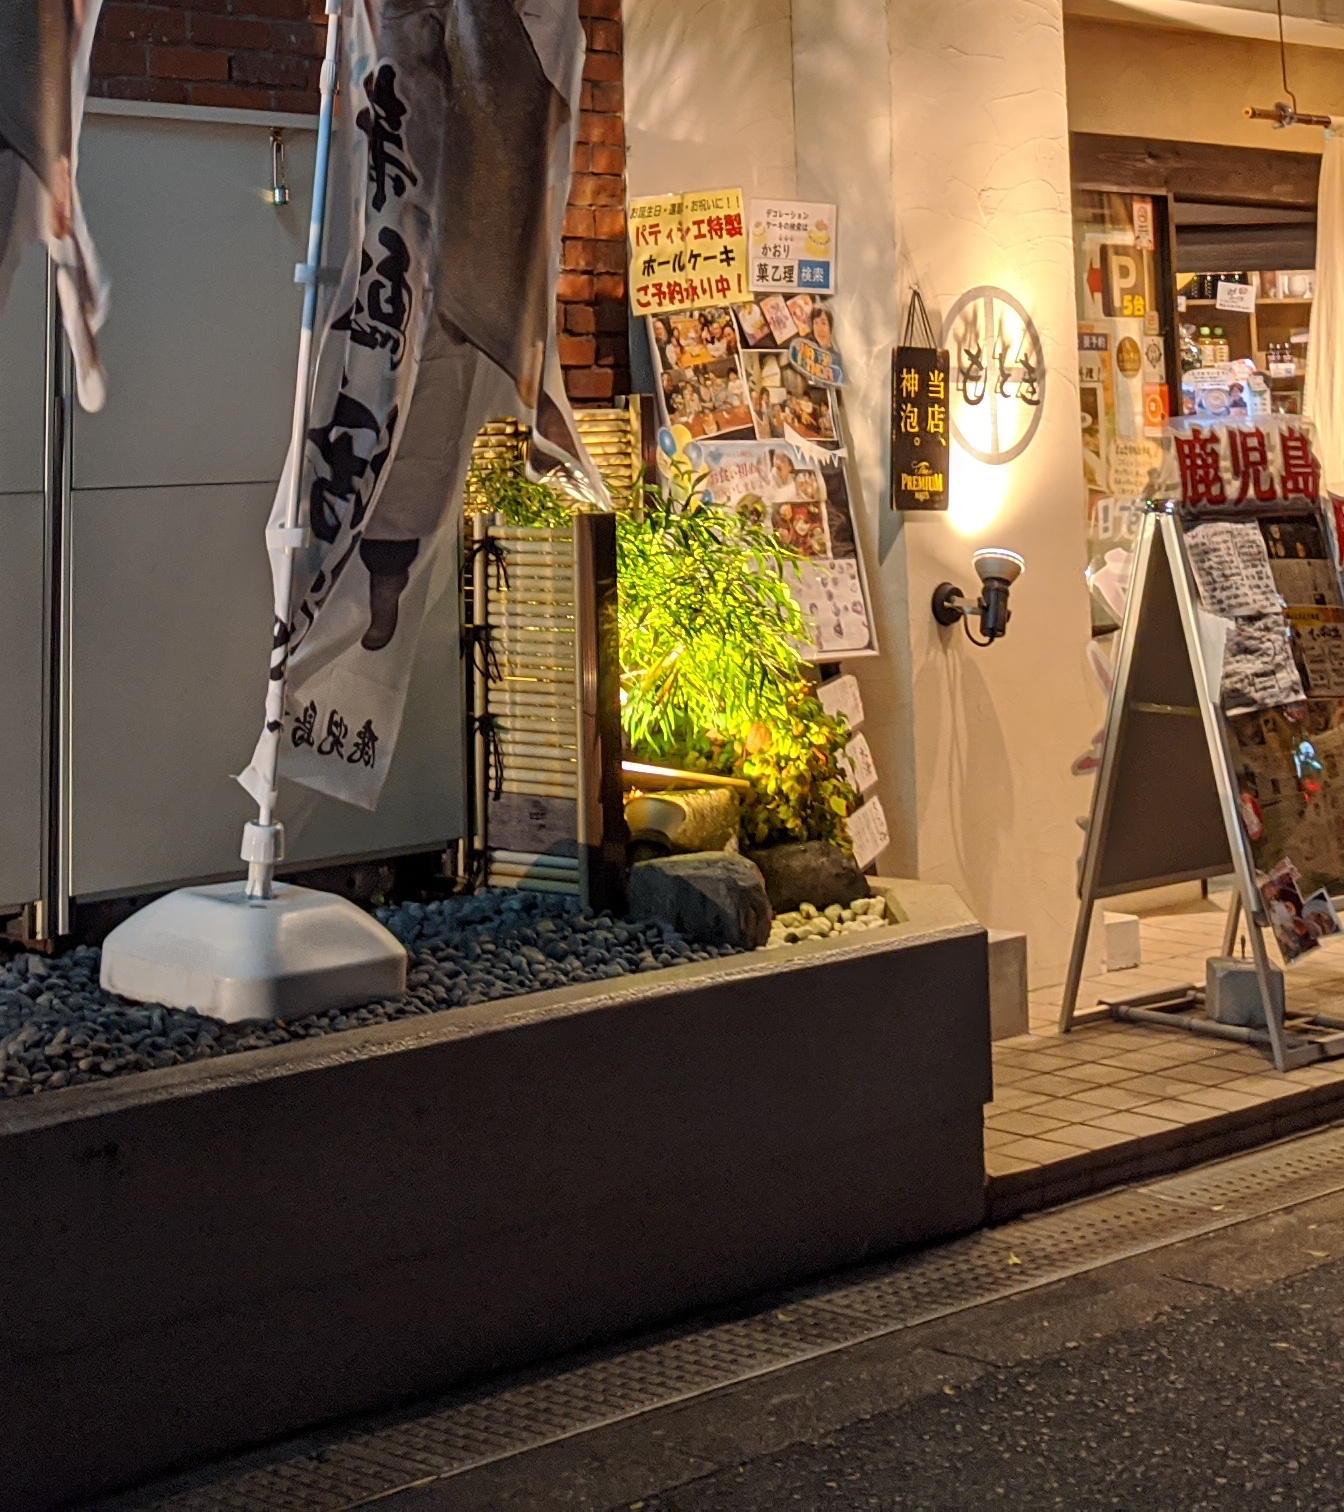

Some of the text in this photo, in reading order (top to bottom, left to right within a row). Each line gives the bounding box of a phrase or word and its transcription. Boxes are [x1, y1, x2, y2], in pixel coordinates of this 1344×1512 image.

[635, 212, 743, 247] パティシエ特製
[766, 208, 809, 220] デコレーション
[641, 245, 736, 277] ホールケーキ
[761, 243, 791, 258] かおり
[636, 273, 743, 308] ご予約承り中！
[801, 266, 824, 283] 検索
[1111, 254, 1137, 308] P
[1122, 294, 1145, 316] 5台
[900, 367, 921, 447] 神泡。
[926, 369, 947, 447] 当店、
[901, 472, 944, 493] PREMIUM
[1175, 426, 1320, 508] 鹿児島
